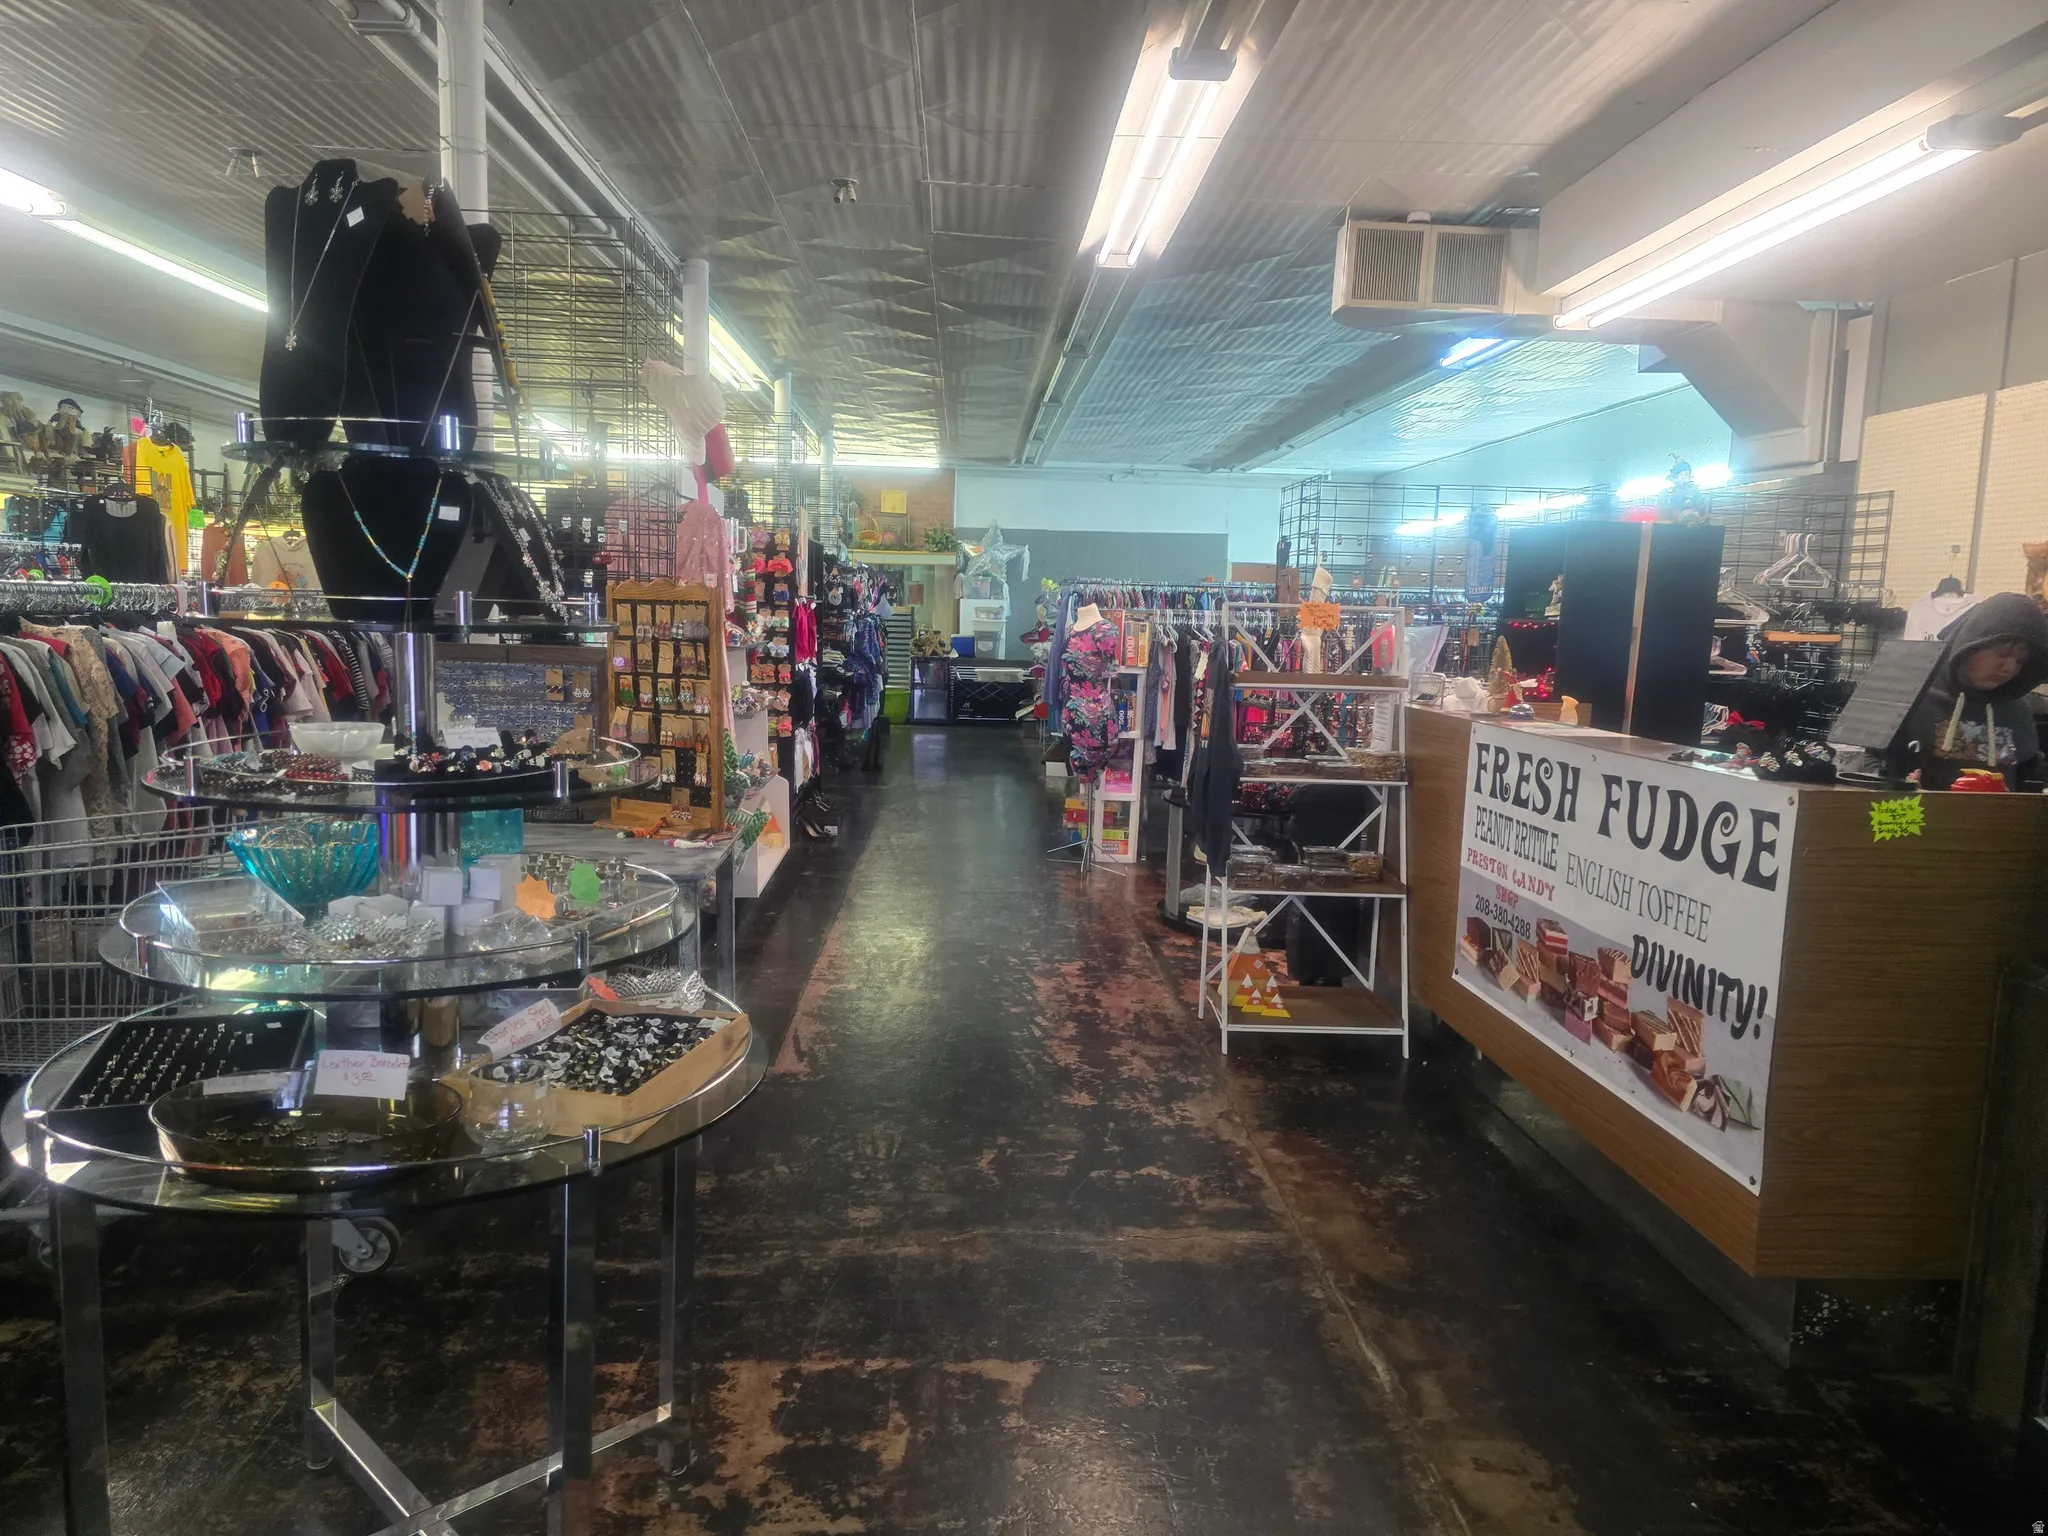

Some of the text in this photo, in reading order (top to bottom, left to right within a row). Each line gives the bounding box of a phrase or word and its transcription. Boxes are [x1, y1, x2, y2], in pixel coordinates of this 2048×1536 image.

[1126, 636, 1135, 658] 1000
[1473, 742, 1780, 892] FRESH FUDGE
[1475, 805, 1559, 872] PEANUT BRITTLE
[1467, 847, 1556, 902] PRESTON CANDY
[1495, 884, 1519, 909] SHOP
[1565, 852, 1712, 943] ENGLISH TOFFEE
[1475, 894, 1531, 940] 208-380-4288
[1631, 934, 1768, 1040] DIVINITY!
